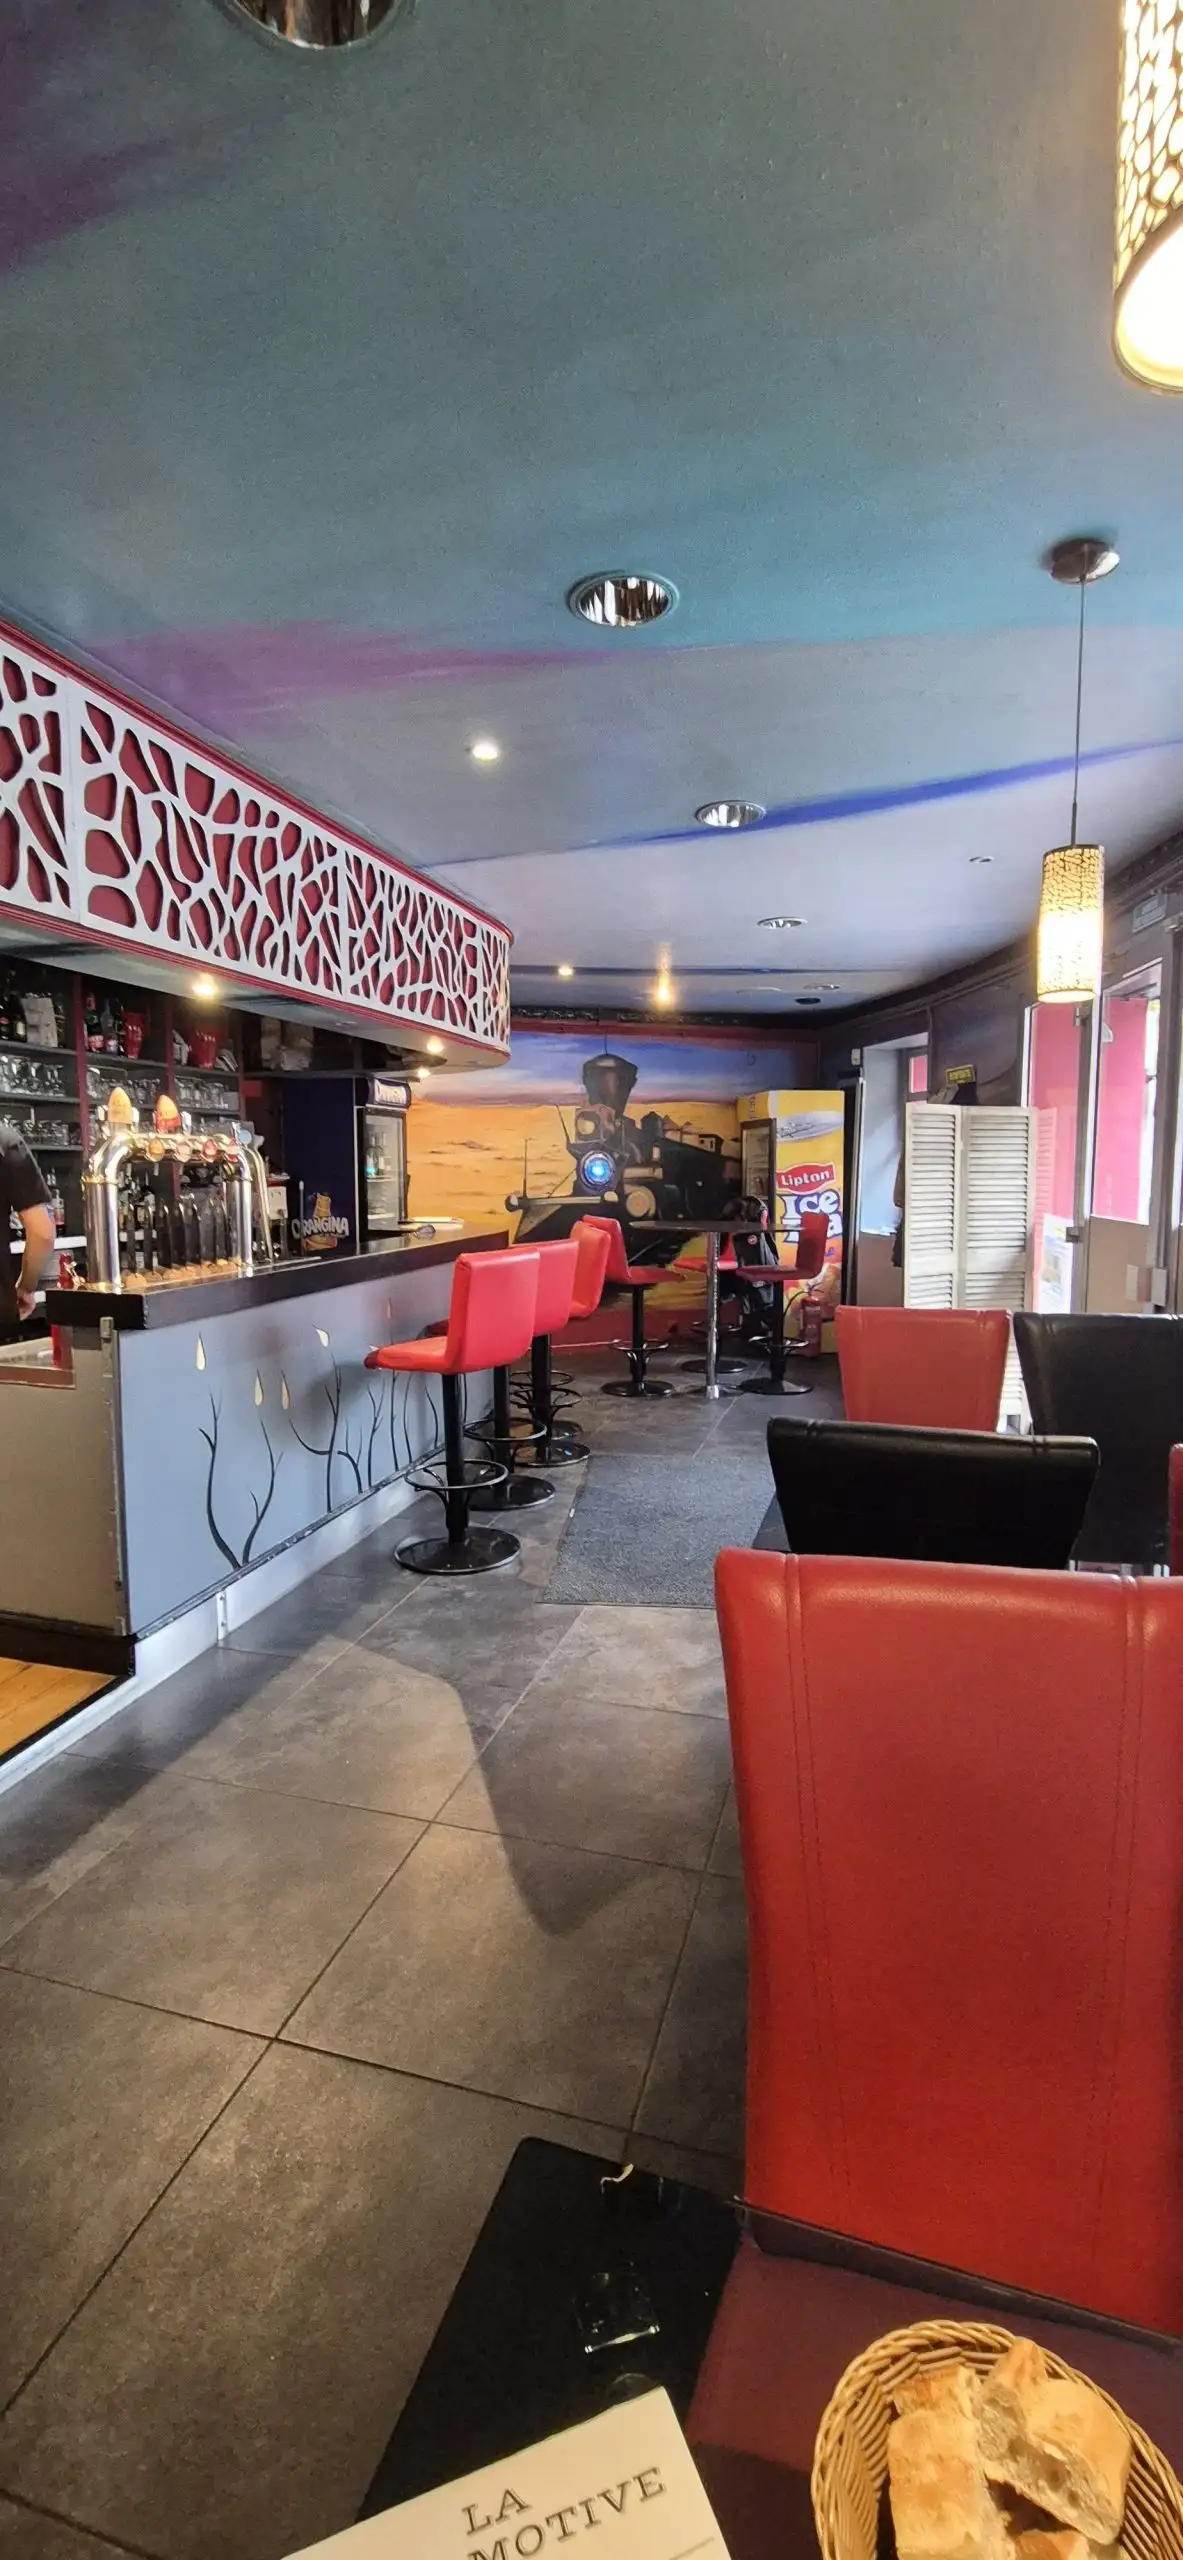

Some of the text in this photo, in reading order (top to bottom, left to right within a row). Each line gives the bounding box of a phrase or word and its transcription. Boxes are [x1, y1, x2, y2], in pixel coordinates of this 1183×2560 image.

[781, 1169, 831, 1187] Lipton
[780, 1190, 841, 1218] Ice
[291, 1216, 350, 1239] ORANGINA
[461, 2488, 532, 2536] LA
